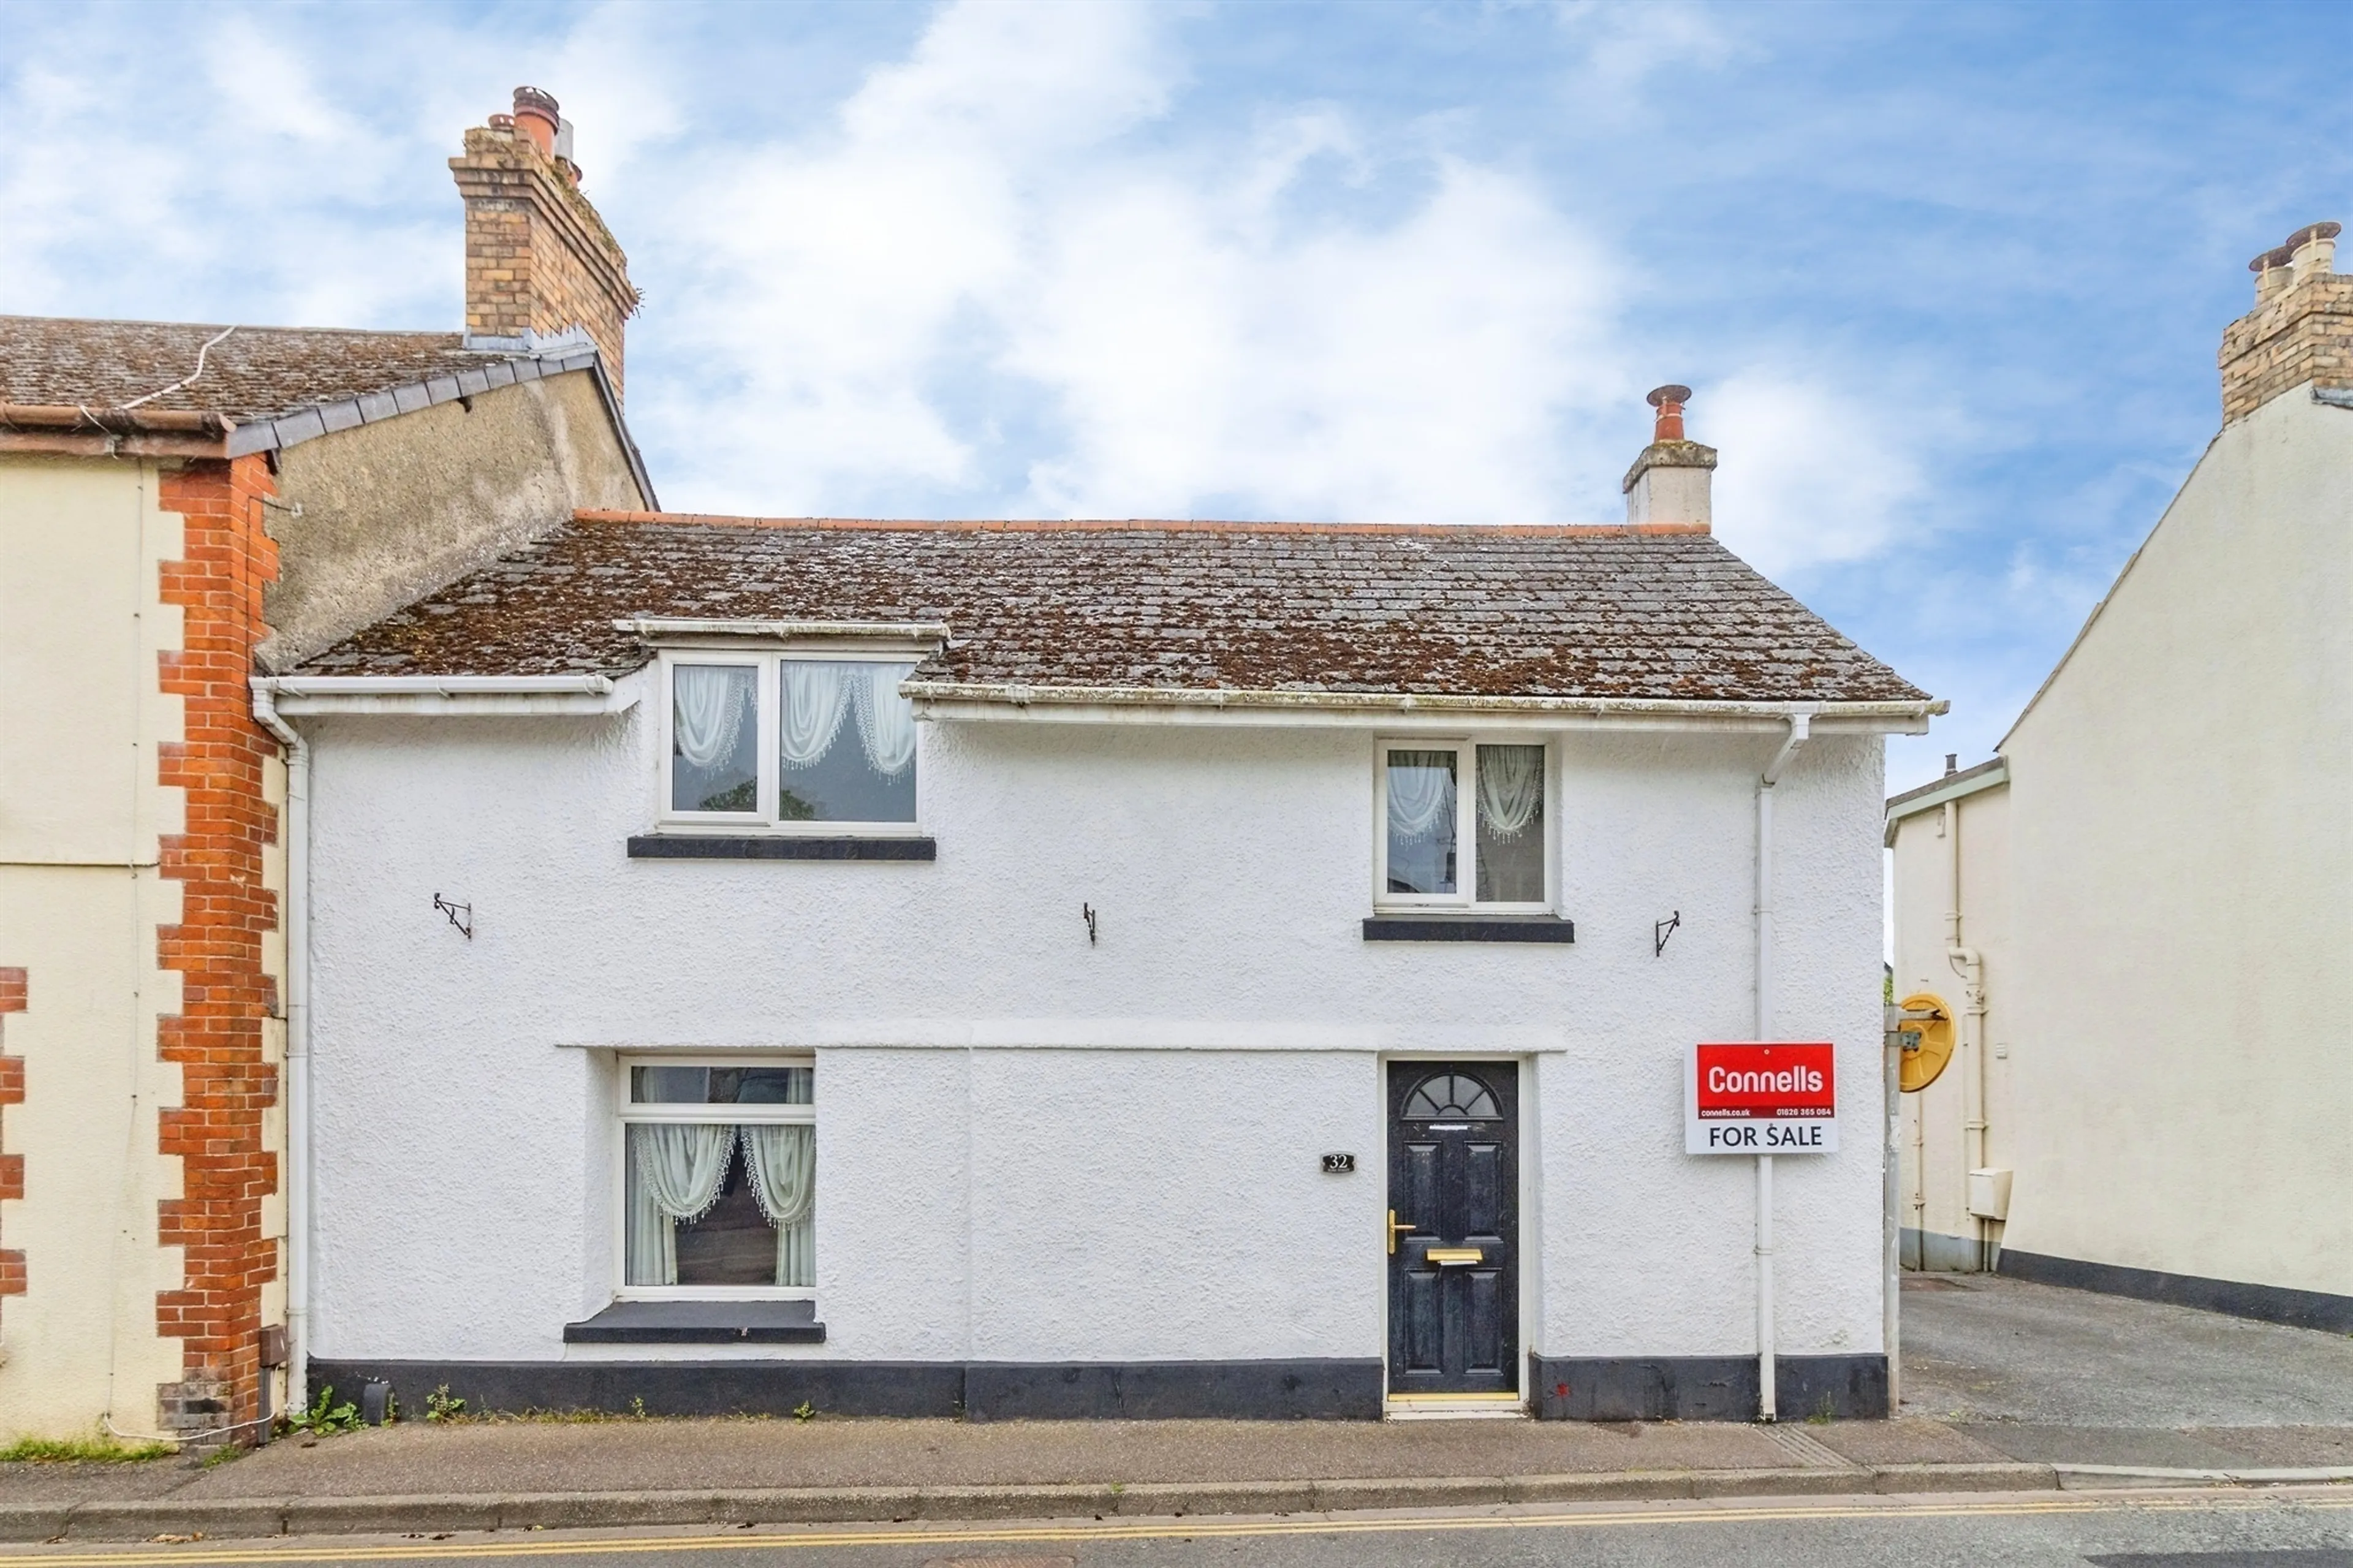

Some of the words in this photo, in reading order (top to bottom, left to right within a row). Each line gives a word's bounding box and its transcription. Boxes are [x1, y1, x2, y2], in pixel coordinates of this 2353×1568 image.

[1708, 1066, 1823, 1093] Connells
[1710, 1127, 1758, 1146] FOR
[1767, 1126, 1822, 1146] SALE
[1330, 1154, 1347, 1168] 32
